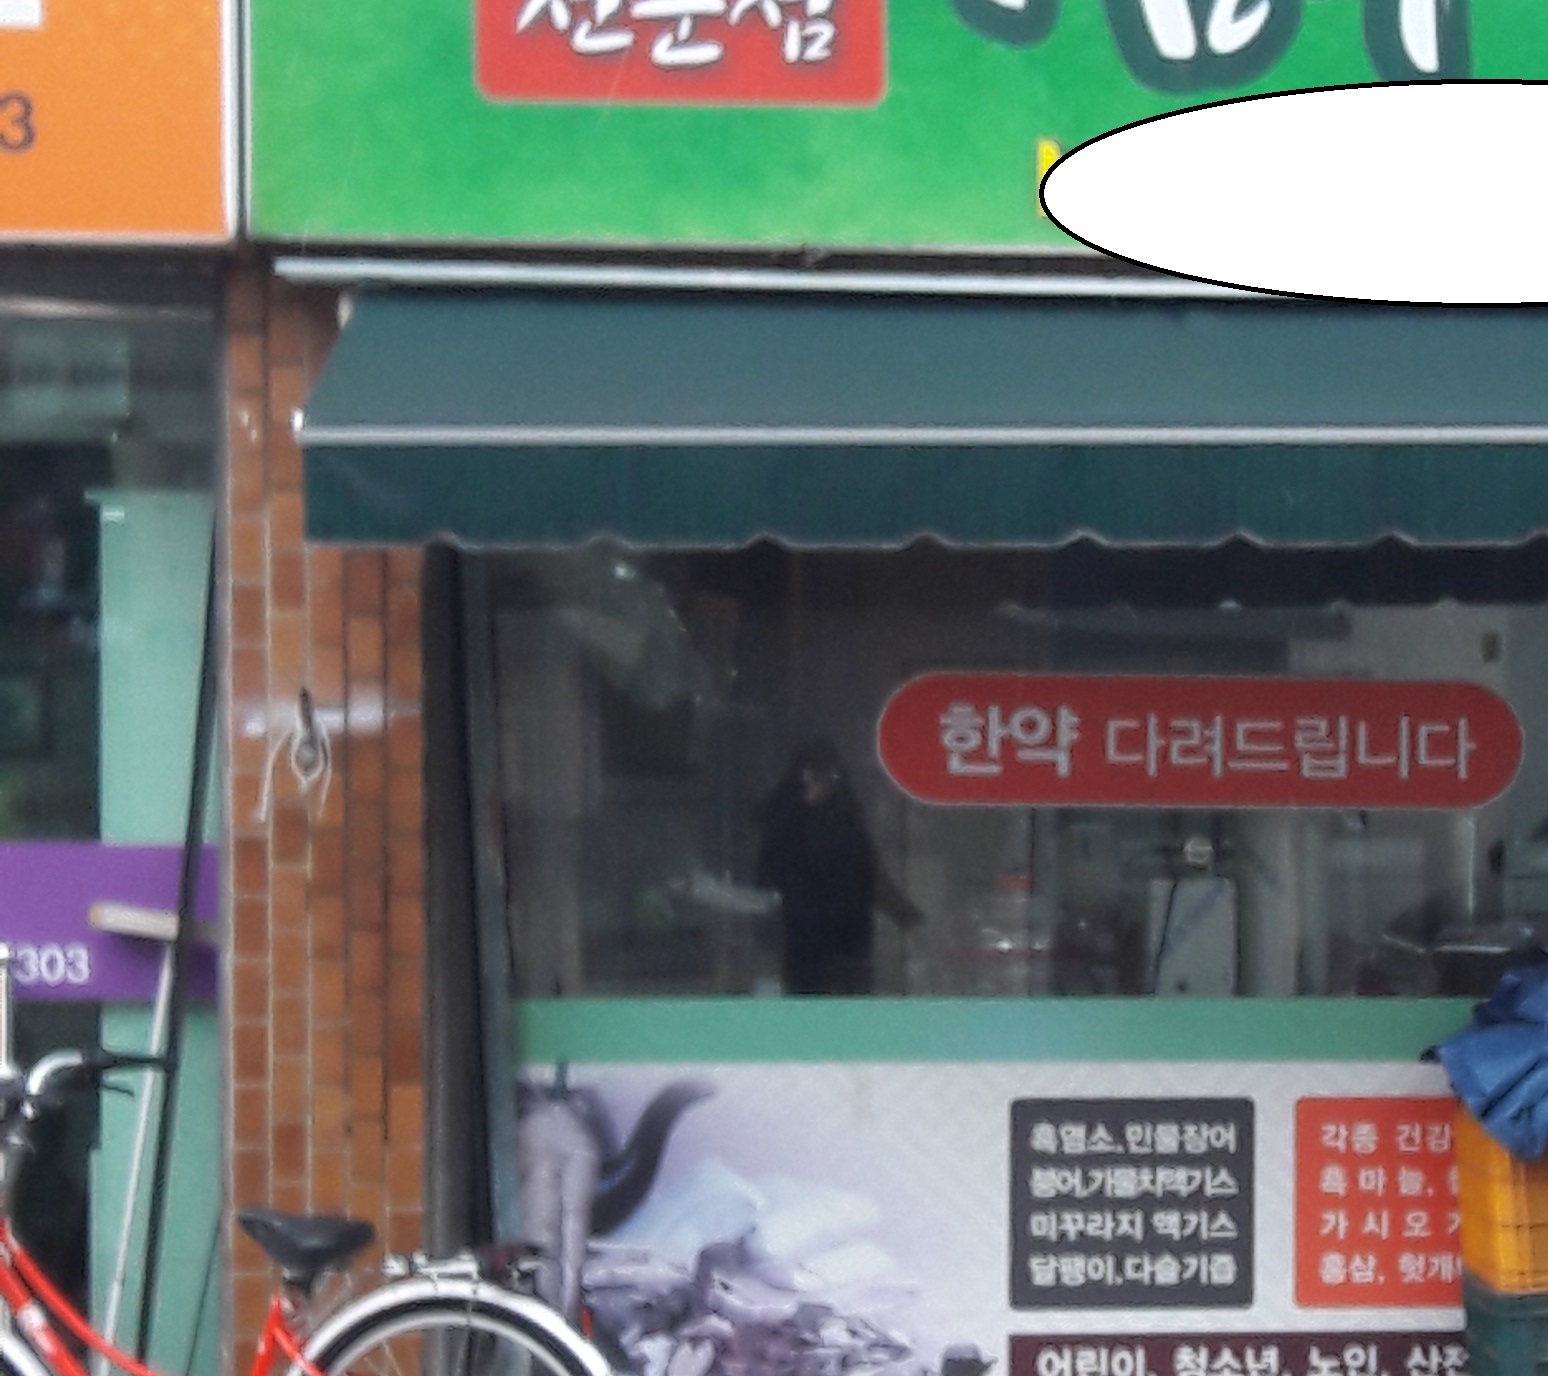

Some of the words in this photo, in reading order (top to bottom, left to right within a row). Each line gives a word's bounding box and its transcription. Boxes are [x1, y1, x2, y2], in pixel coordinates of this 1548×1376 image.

[939, 702, 1081, 778] 한약
[1106, 713, 1476, 779] 다려드립니다
[1321, 1122, 1379, 1155] 각종
[1030, 1210, 1145, 1242] 미꾸라지
